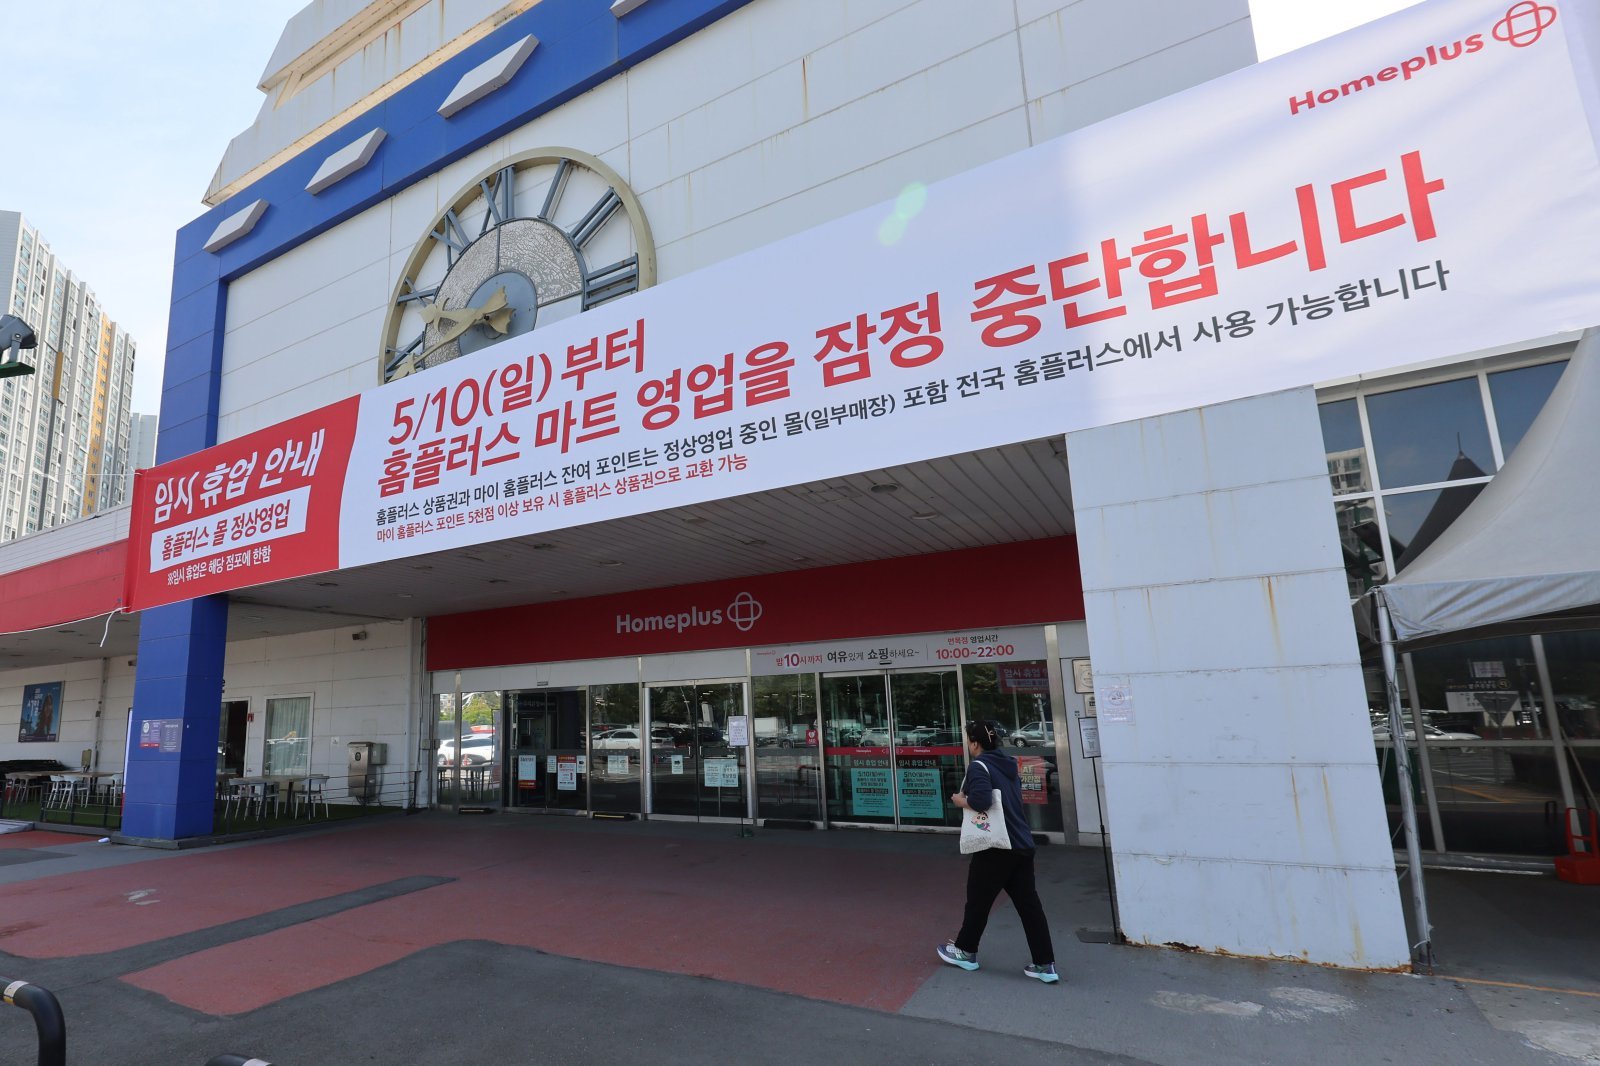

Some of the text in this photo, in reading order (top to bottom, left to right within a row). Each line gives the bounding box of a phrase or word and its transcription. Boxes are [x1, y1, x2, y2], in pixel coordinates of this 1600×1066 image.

[1289, 33, 1485, 115] Homeplus
[377, 150, 1446, 498] 홈플러스 마트 영업을 잠정 중단합니다
[376, 259, 1451, 526] 홈플러스 상품권과 마이 홈플러스 잔여 포인트는 정상영업 중인 몰(일부매장) 포함 전국 홈플러스에서 사용 가능합니다
[153, 428, 326, 525] 임시 휴업 안내
[376, 451, 749, 543] 마이 홈플러스 포인트 5천점 이상 보유 시 홈플러스 상품권으로 교환 가능
[161, 499, 291, 563] 홈플러스 몰 정상영업
[185, 561, 208, 583] 휴업은
[208, 557, 225, 576] 해당
[225, 552, 251, 573] 점포에
[252, 545, 272, 566] 한함
[616, 606, 723, 634] Homeplus
[935, 644, 1015, 660] 10:00~22:00
[969, 634, 999, 644] 영업시간
[827, 651, 864, 663] 여유있게
